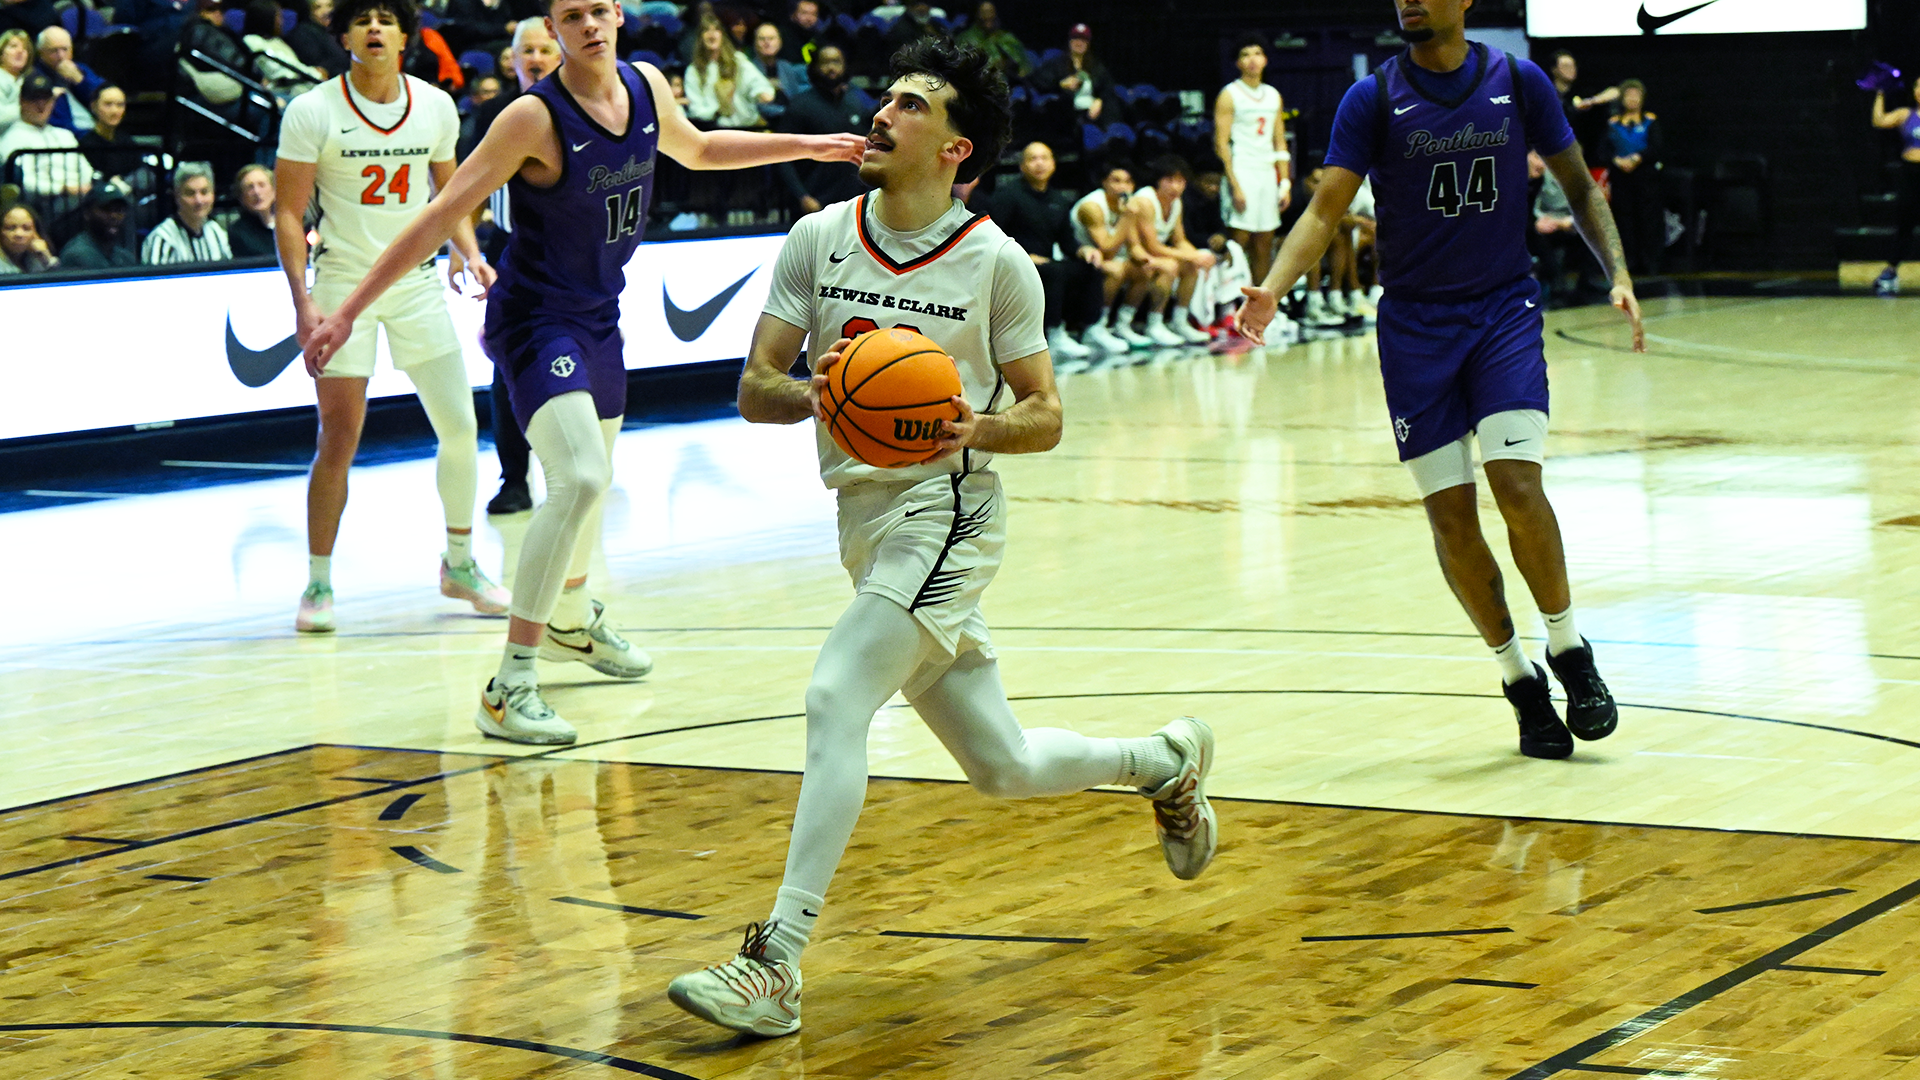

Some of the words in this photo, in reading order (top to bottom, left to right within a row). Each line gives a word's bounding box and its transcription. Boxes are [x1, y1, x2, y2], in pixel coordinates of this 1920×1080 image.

[341, 149, 380, 157] LEWIS
[393, 147, 429, 156] CLARK
[1404, 117, 1510, 158] Portland
[361, 164, 410, 205] 24
[1426, 156, 1498, 217] 44
[605, 185, 642, 243] 14
[819, 286, 881, 306] LEWIS
[882, 295, 895, 308] &
[898, 298, 967, 321] CLARK
[894, 417, 952, 441] Wil
